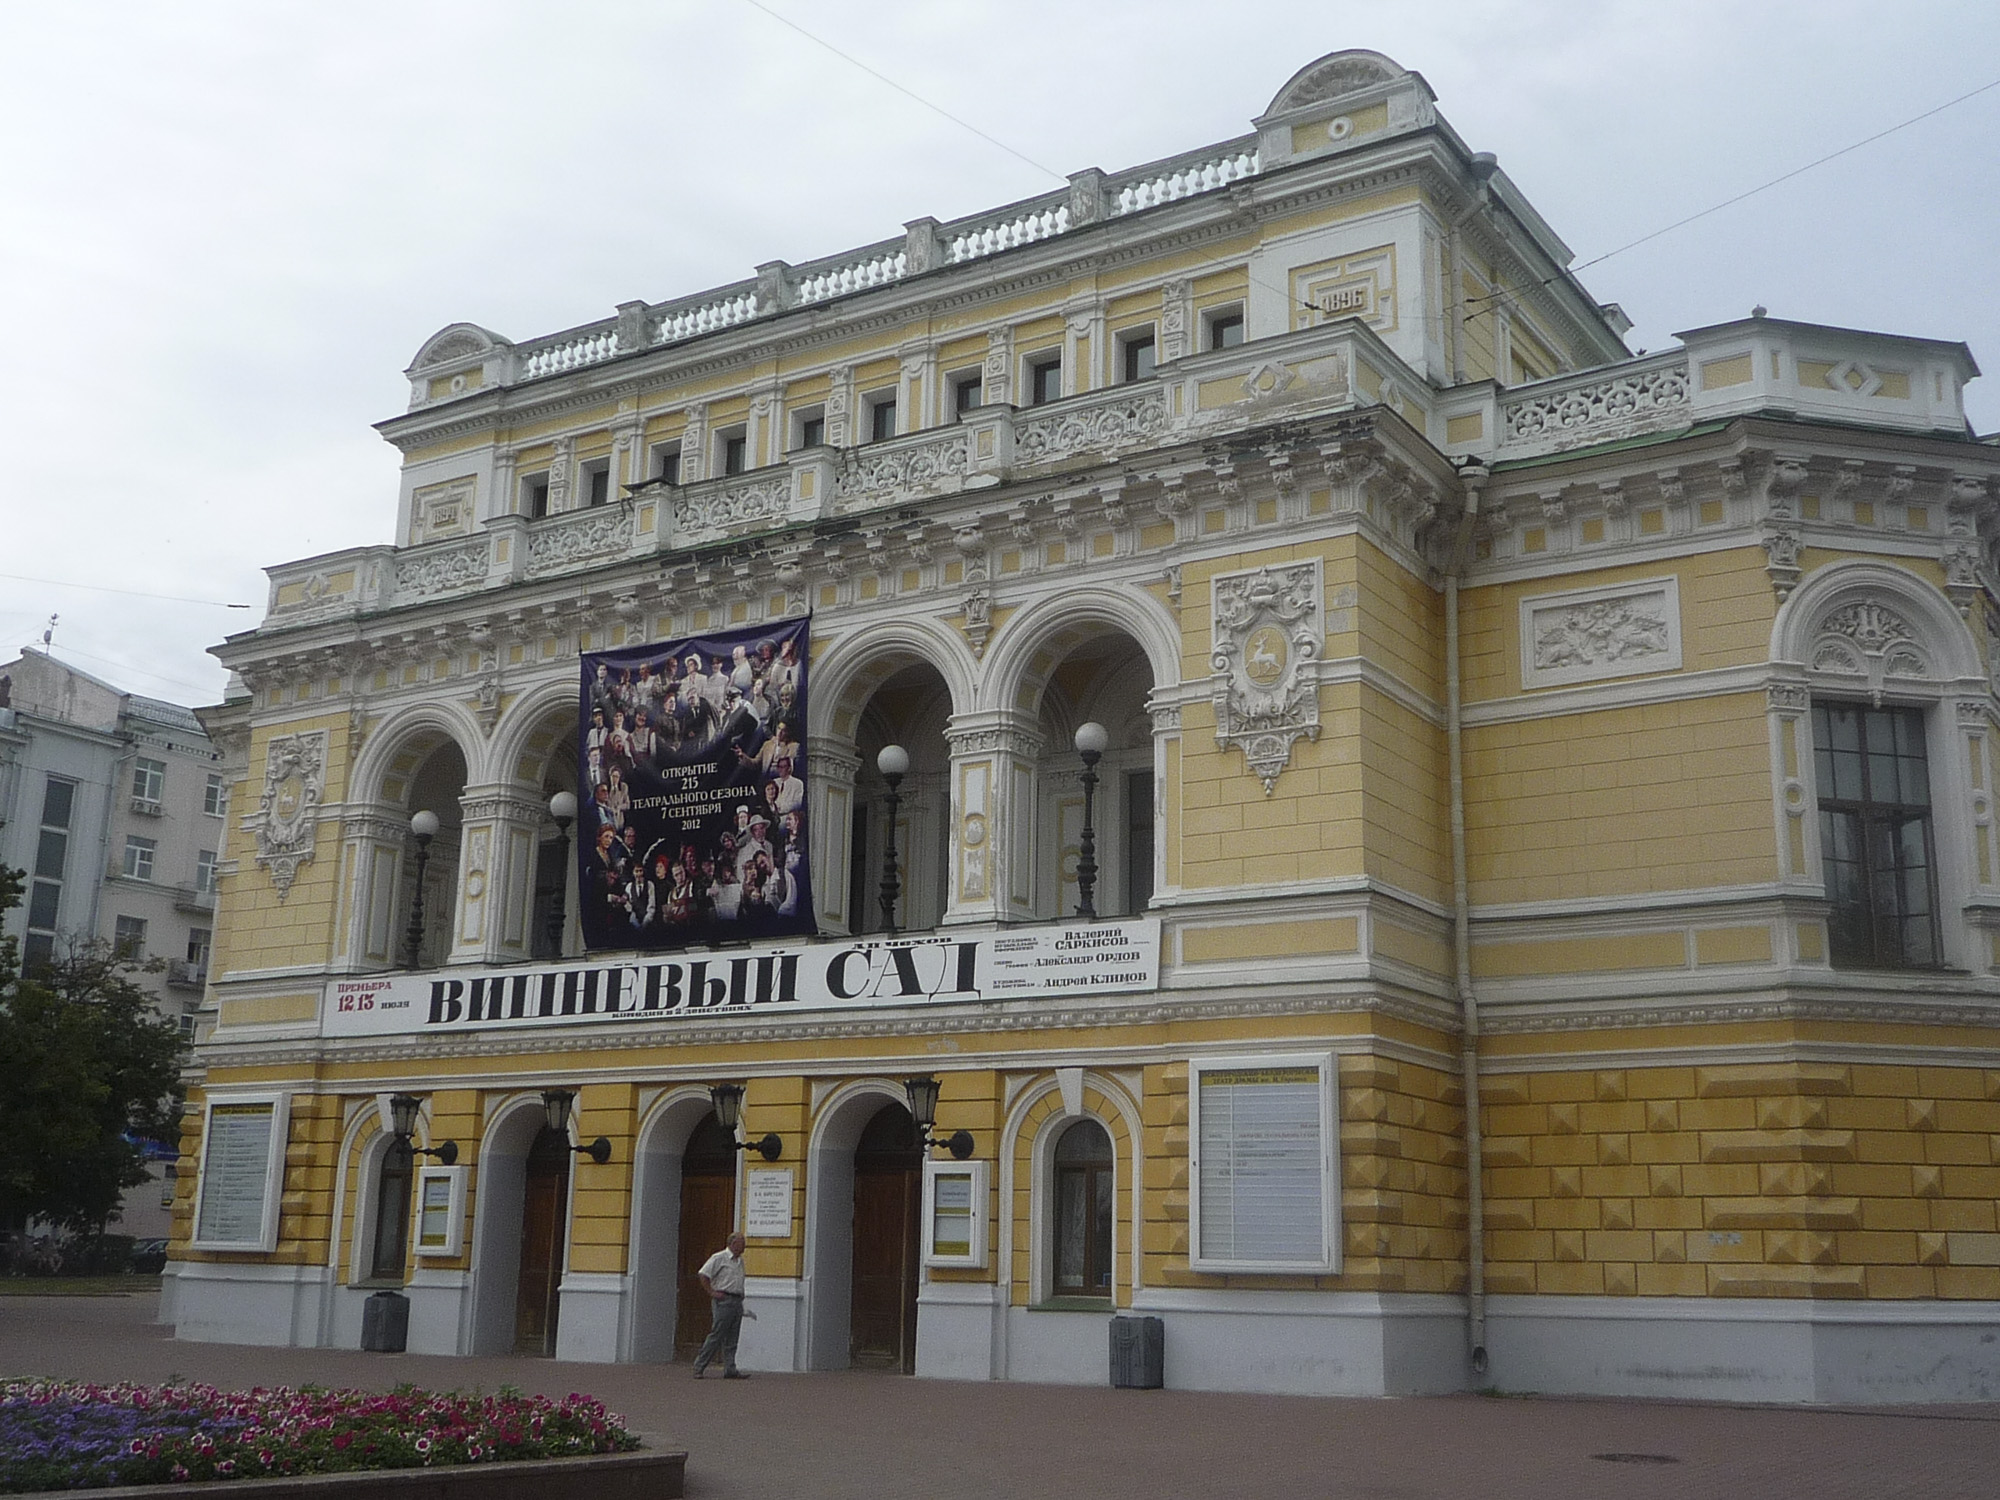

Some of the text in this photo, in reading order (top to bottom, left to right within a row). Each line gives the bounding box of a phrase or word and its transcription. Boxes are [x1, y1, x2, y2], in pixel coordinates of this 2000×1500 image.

[1323, 289, 1363, 313] 1896
[662, 763, 718, 779] ОТКРЫТИЕ
[681, 777, 699, 790] 215
[633, 785, 757, 809] ТЕАТРАЛЬНОГО СЕЗОНА
[661, 803, 722, 819] 7 СЕНТЯБРЯ
[682, 819, 700, 830] 2012
[1055, 937, 1129, 951] САРКИСОВ
[1096, 951, 1140, 963] ОРЛОВ
[424, 941, 983, 1023] ВИШНЁВЫЙ САД
[1090, 972, 1147, 985] КЛИМОВ
[338, 981, 392, 993] ПРЕМЬЕРА
